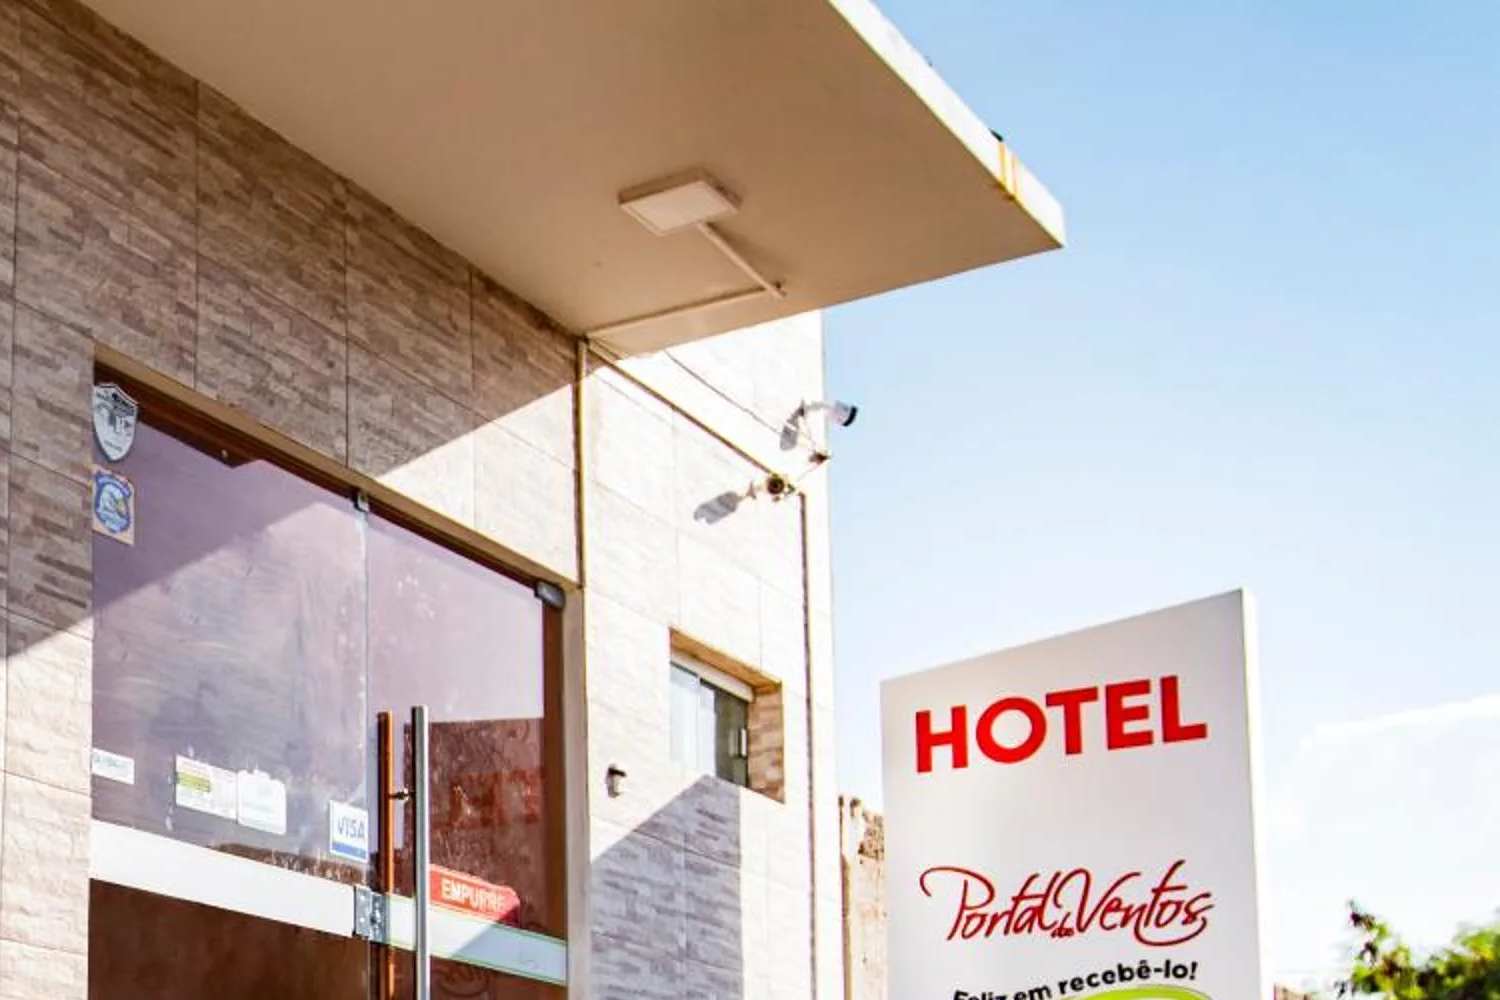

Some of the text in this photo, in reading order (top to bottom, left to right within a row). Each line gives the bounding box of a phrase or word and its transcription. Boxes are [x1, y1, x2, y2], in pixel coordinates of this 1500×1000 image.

[915, 675, 1208, 774] HOTEL
[337, 817, 366, 840] VISA
[919, 866, 1062, 941] Portal
[1054, 859, 1214, 947] Ventos
[1058, 959, 1199, 997] recebê-lo!
